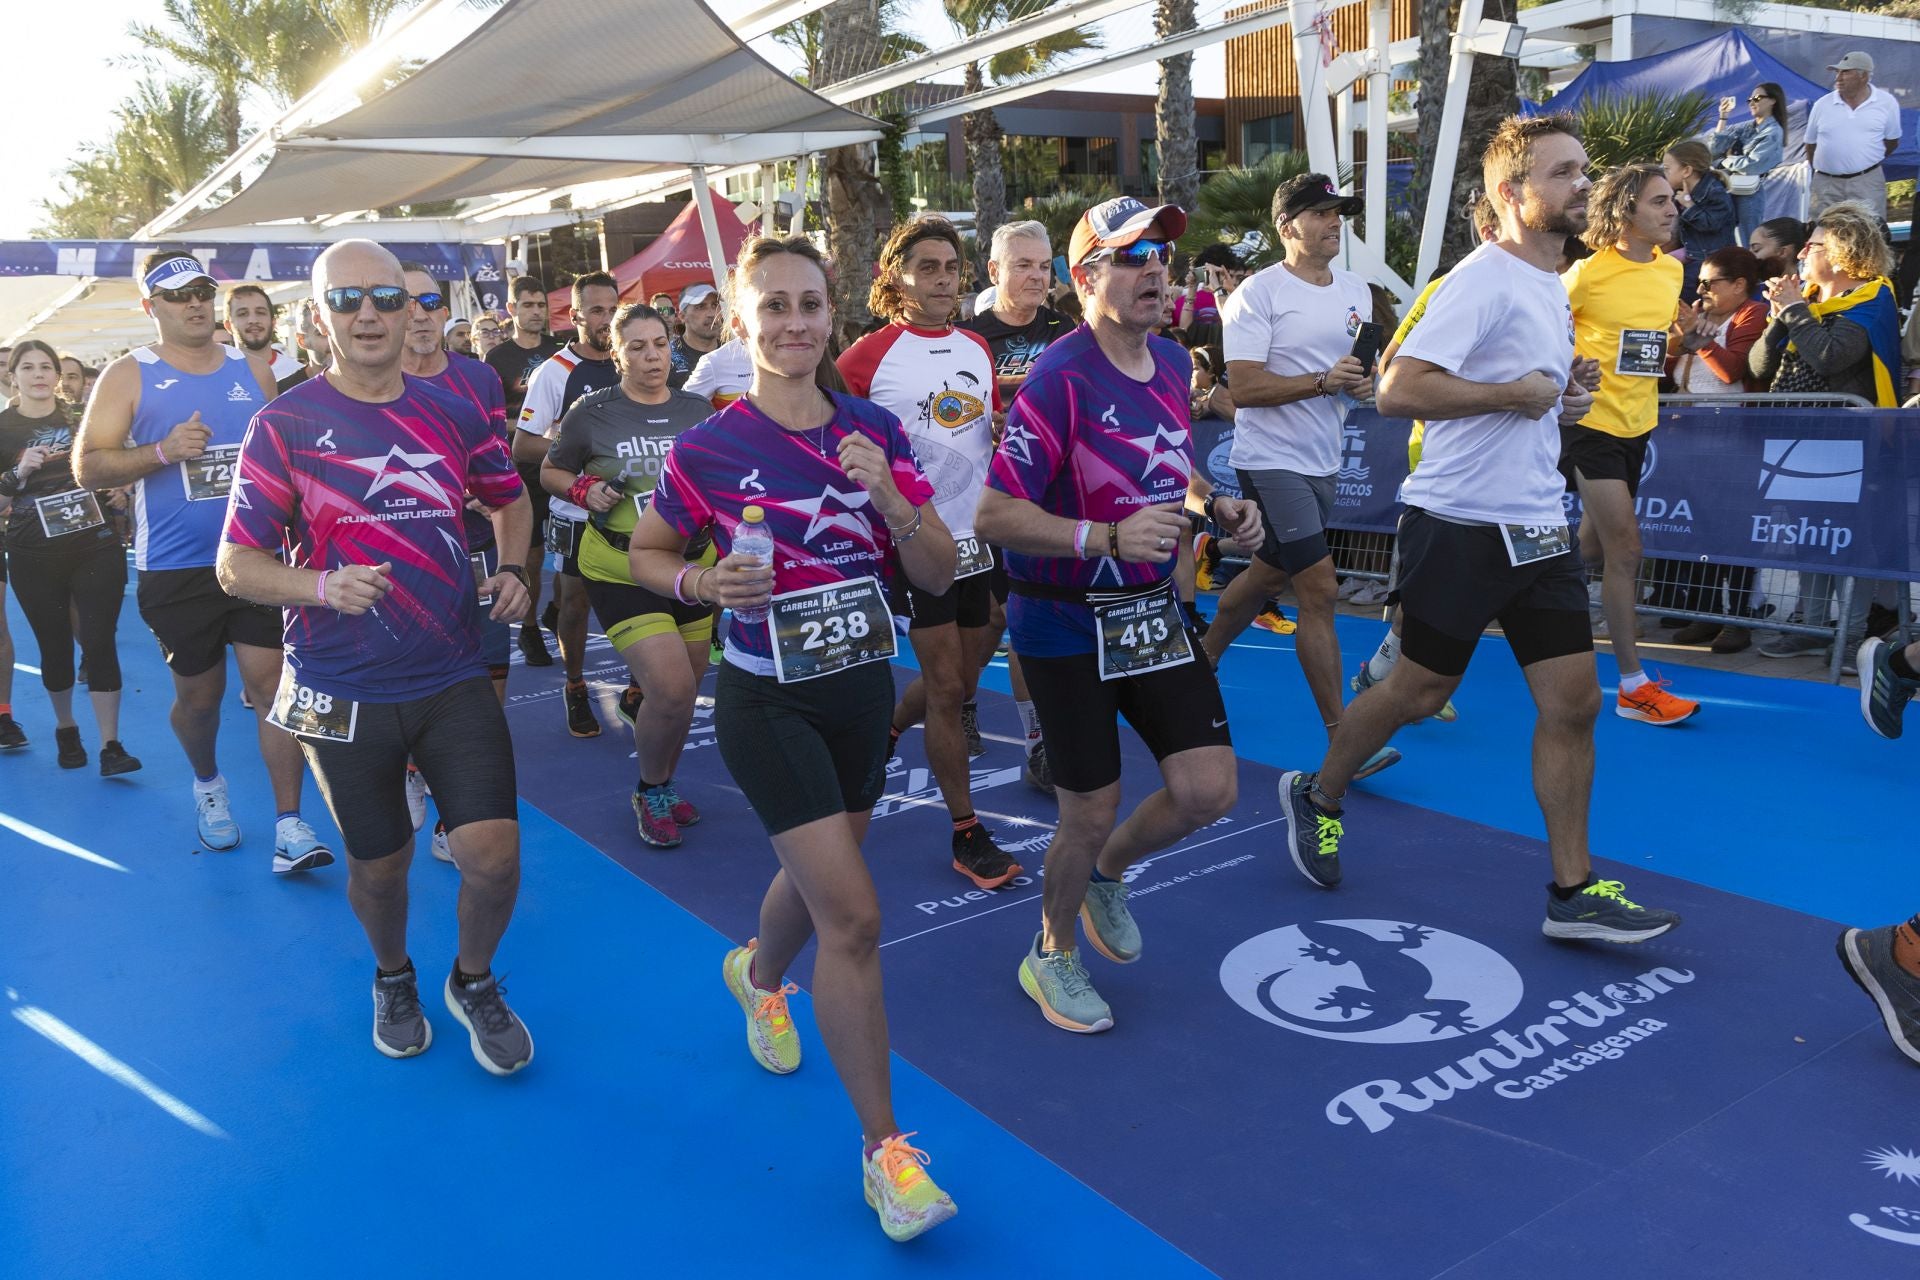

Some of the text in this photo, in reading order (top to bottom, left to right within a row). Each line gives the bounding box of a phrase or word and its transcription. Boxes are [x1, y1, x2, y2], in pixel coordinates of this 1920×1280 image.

[1640, 343, 1660, 360] 59
[1153, 477, 1176, 489] LOS
[60, 503, 85, 520] 34
[384, 498, 418, 508] LOS
[335, 509, 457, 525] RUNNINGUEROS
[1751, 515, 1853, 555] Ership
[822, 541, 854, 553] LOS
[956, 538, 980, 559] 30
[781, 588, 872, 613] CARRERA IX SOLIDARIA
[1107, 606, 1135, 618] CARRERA
[1136, 599, 1148, 614] IX
[800, 610, 870, 651] 238
[1120, 617, 1169, 648] 413
[826, 644, 852, 657] JOANA
[1188, 853, 1257, 877] Cartagena
[1493, 1016, 1669, 1100] Cartagena
